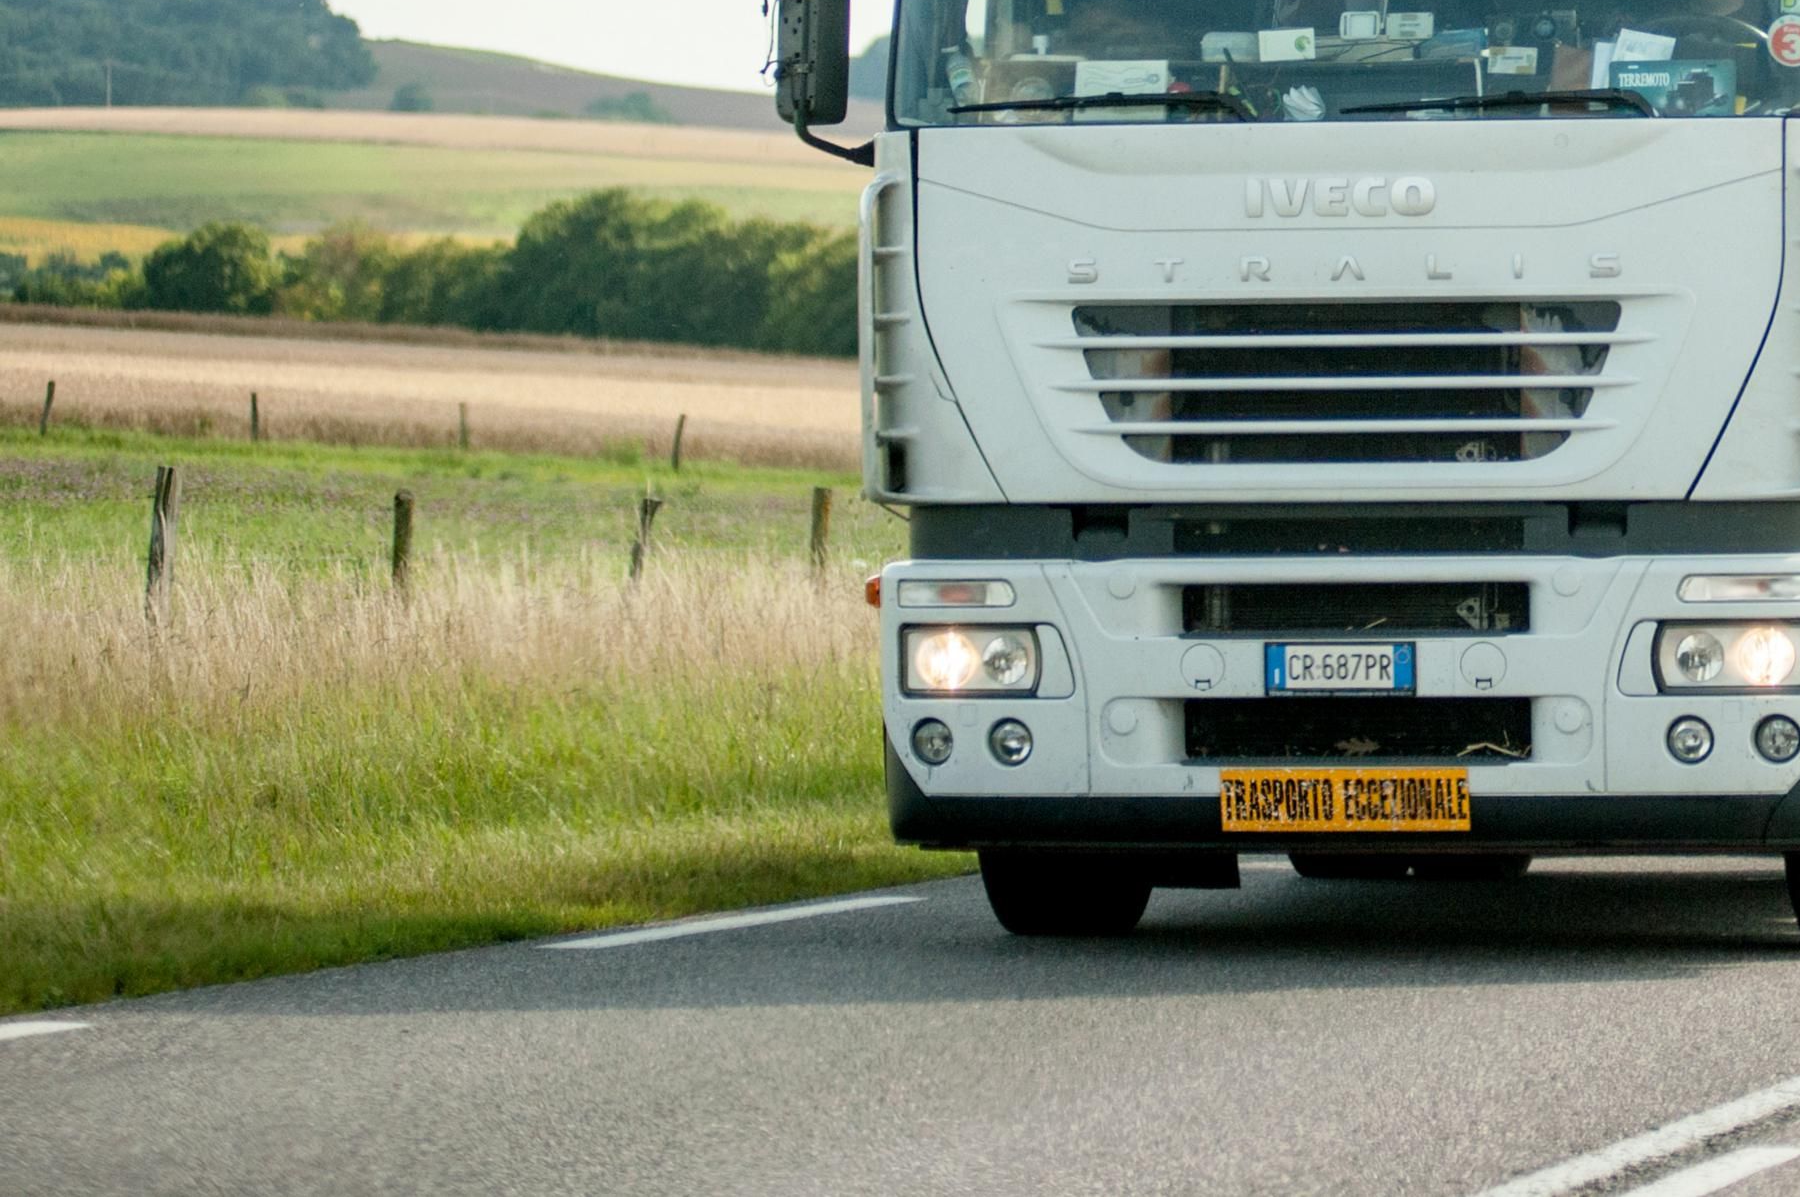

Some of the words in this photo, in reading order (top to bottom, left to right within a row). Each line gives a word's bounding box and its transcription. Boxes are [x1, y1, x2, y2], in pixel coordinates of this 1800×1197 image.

[1618, 72, 1671, 88] TERREMOTO
[1244, 176, 1437, 219] IVECO
[1067, 251, 1623, 285] STRALIS
[1222, 777, 1334, 822] TRASPORTO
[1342, 776, 1468, 822] ECCEZIONALE
